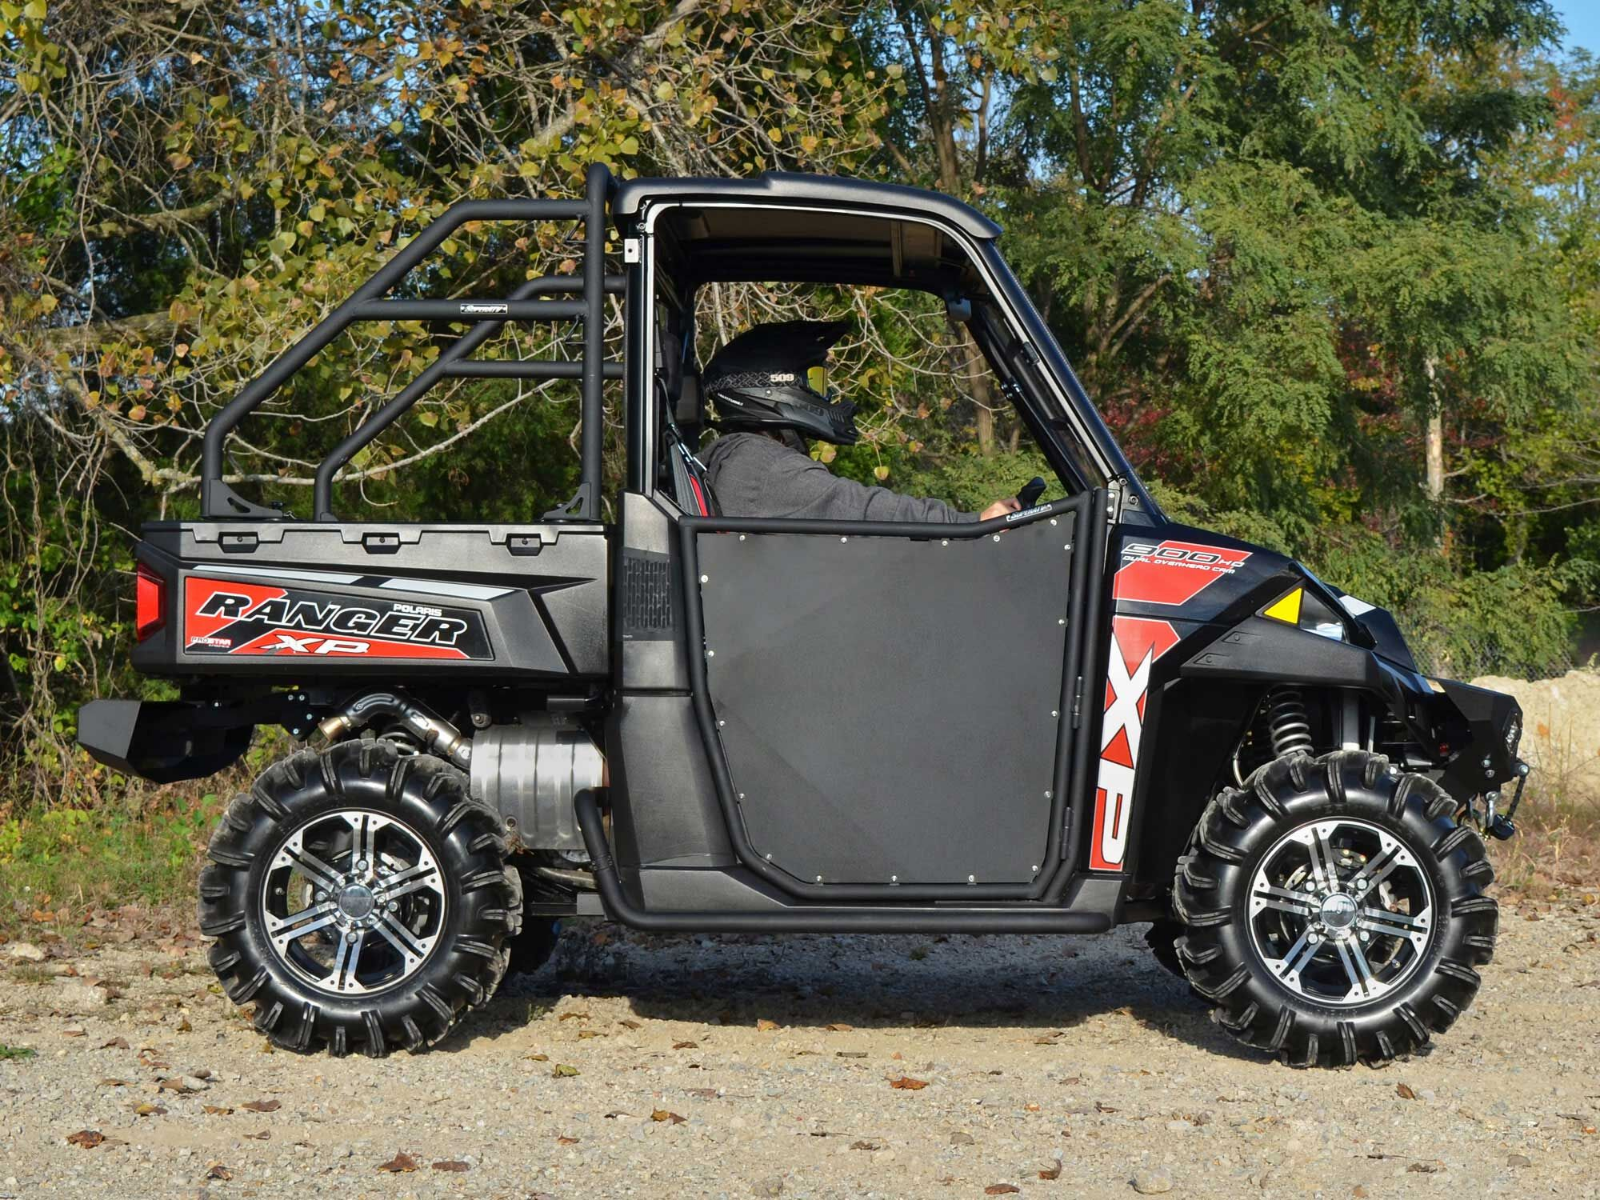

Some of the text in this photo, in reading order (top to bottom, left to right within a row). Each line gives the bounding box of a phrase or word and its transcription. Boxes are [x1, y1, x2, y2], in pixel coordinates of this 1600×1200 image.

[770, 373, 795, 382] 509
[1153, 559, 1210, 571] OVERHEAD
[1211, 567, 1236, 575] CAM
[195, 591, 468, 646] RANGER
[393, 603, 443, 616] POLARIS
[263, 634, 370, 654] XP
[1097, 631, 1154, 864] XP
